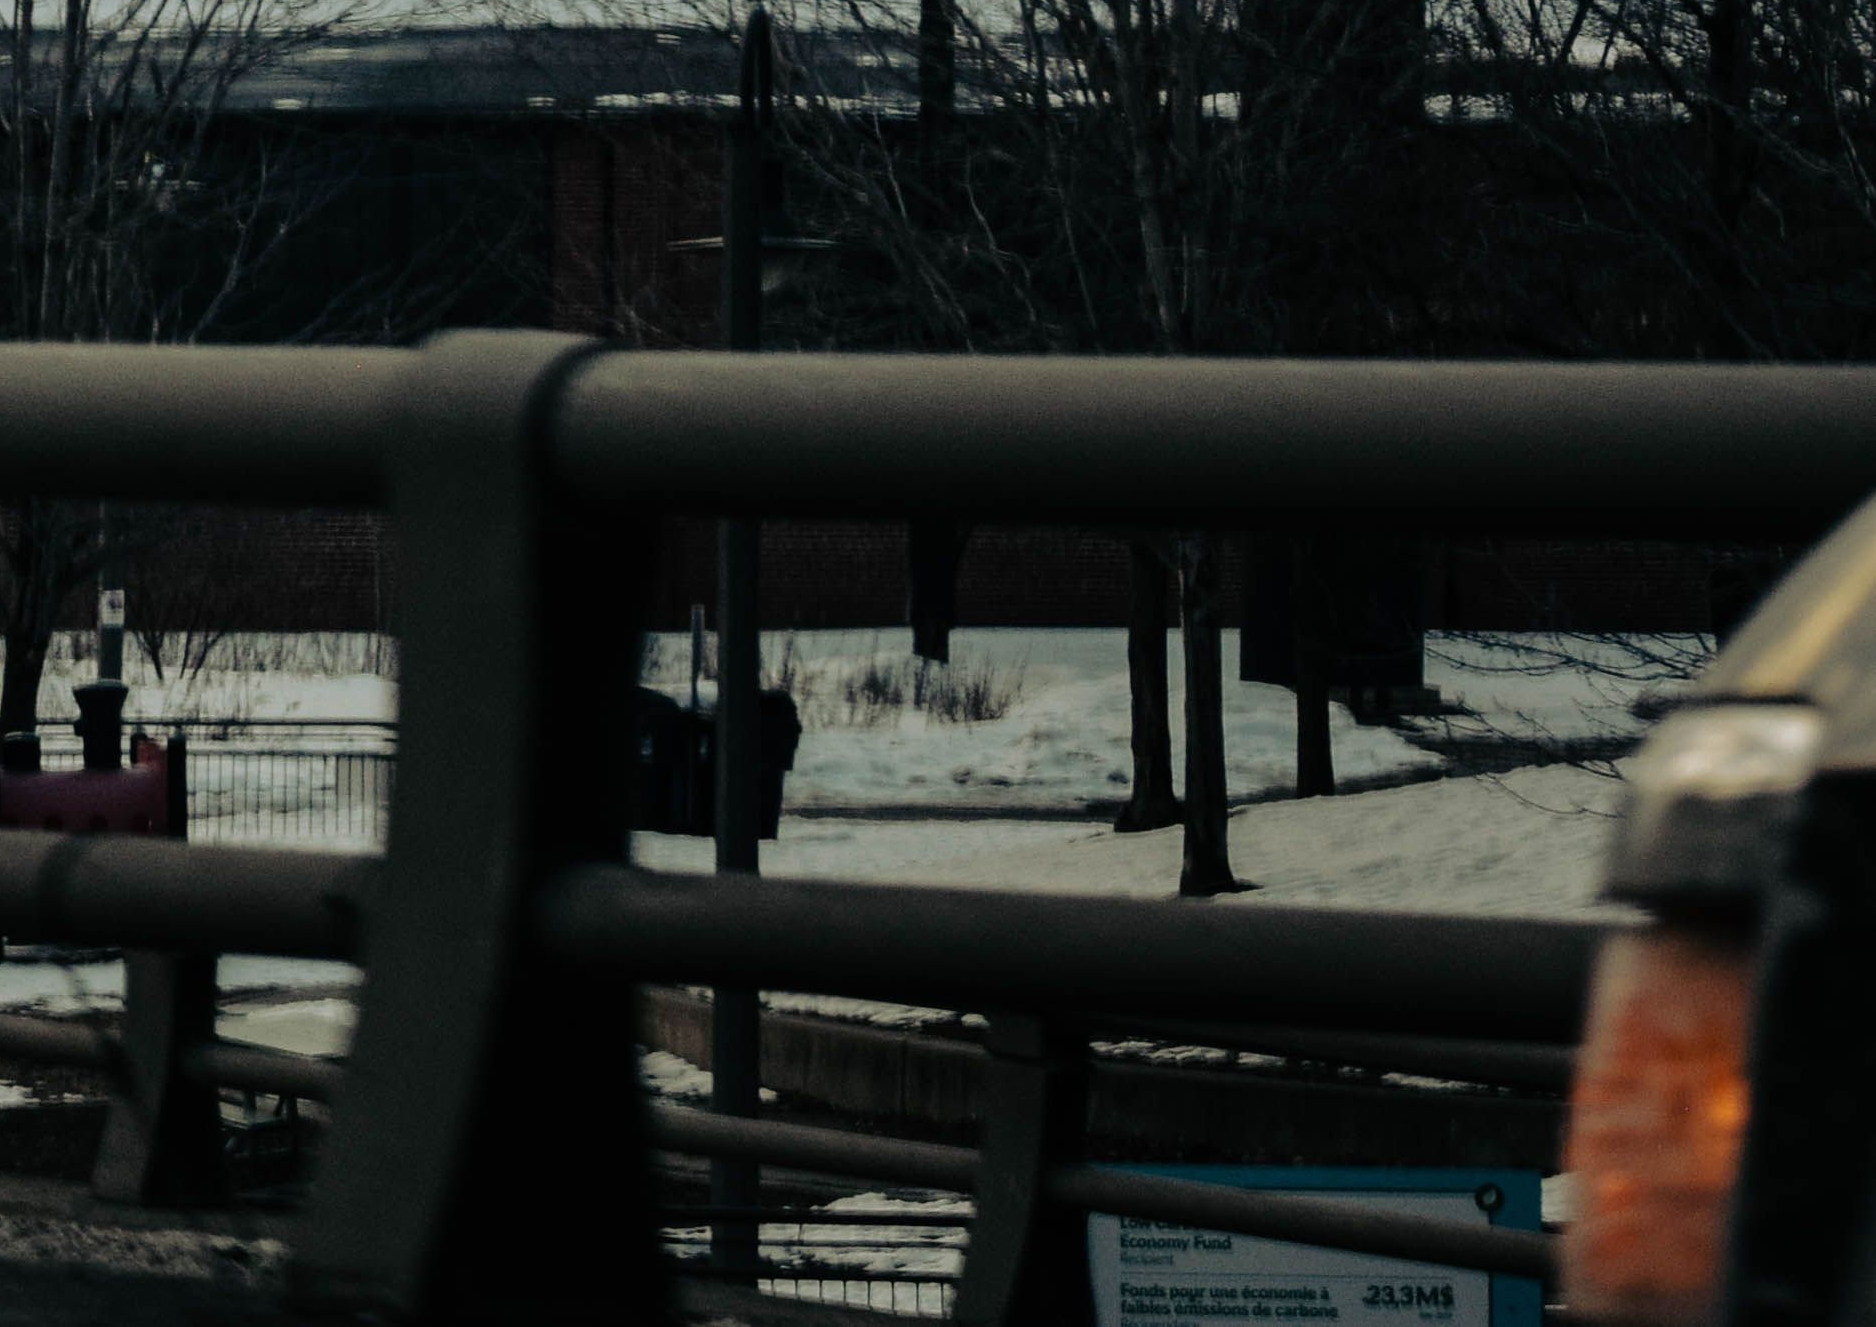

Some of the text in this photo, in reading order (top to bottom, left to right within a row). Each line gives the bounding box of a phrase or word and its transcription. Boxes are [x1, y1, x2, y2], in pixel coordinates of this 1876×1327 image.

[1120, 1235, 1232, 1250] Economy Fund
[1120, 1283, 1166, 1297] Fonds
[1169, 1287, 1205, 1300] pour
[1209, 1288, 1238, 1298] une
[1241, 1285, 1317, 1299] économie
[1120, 1300, 1339, 1317] faibles émissions de carbone
